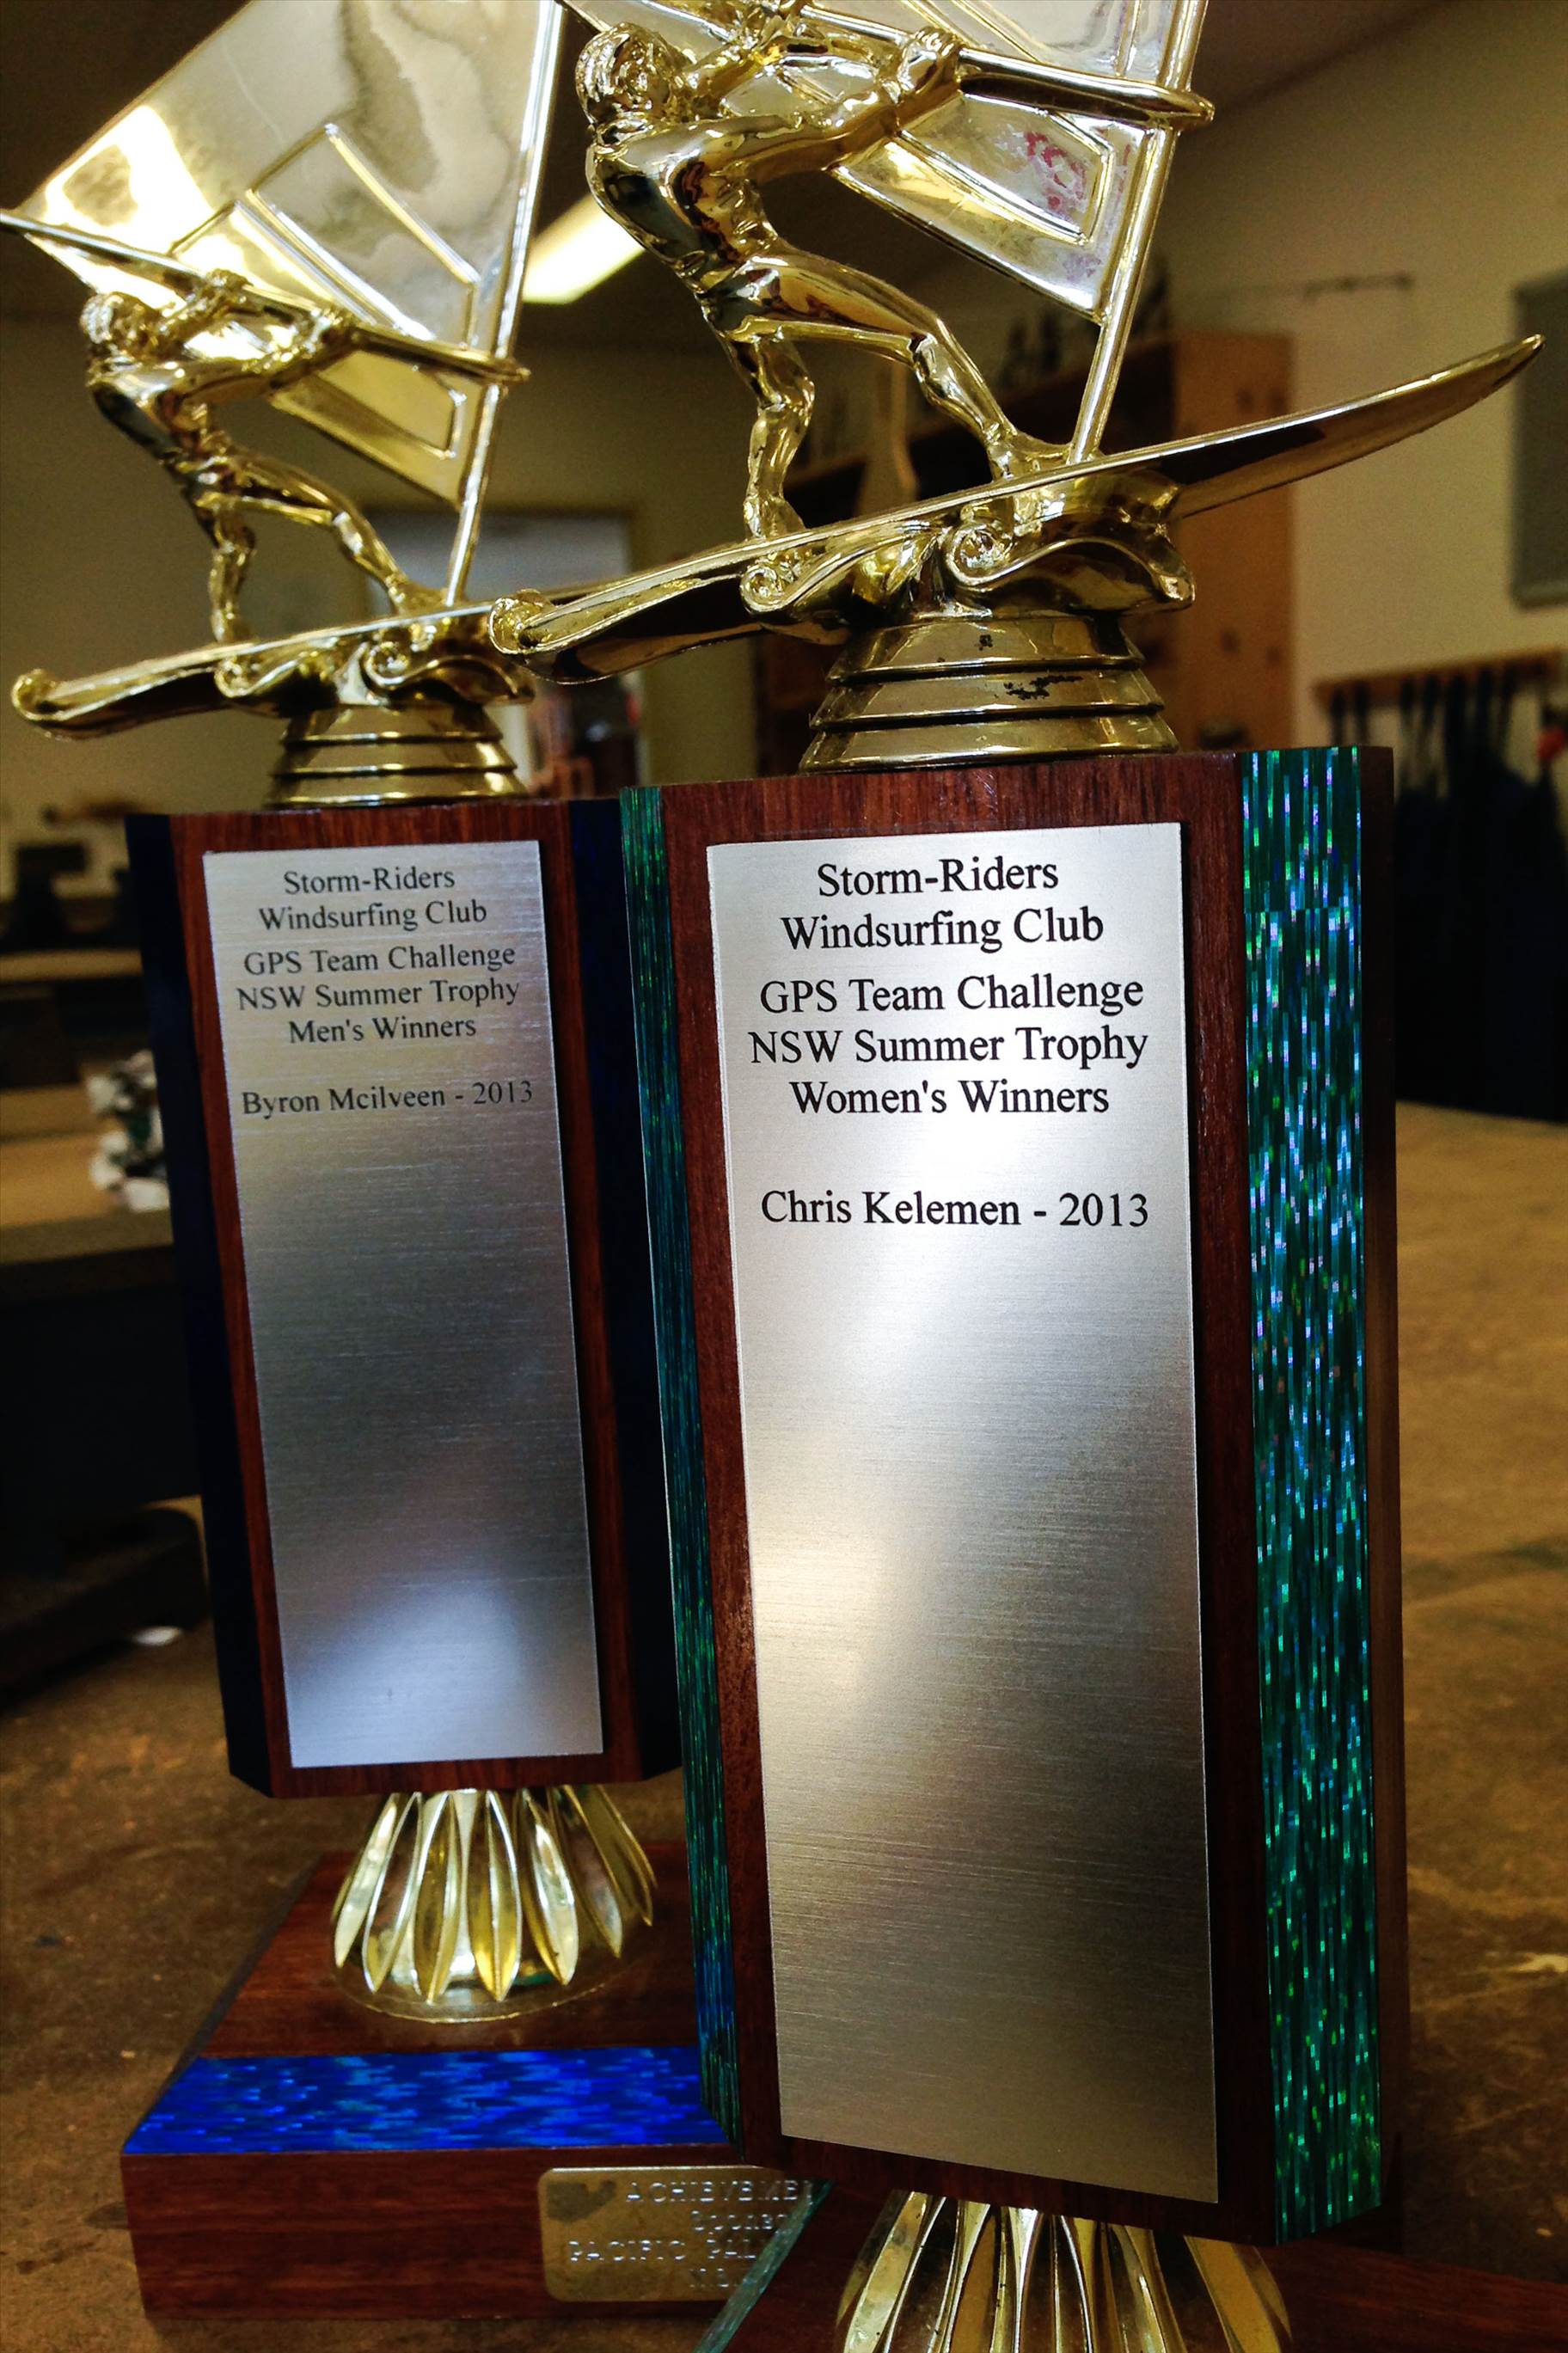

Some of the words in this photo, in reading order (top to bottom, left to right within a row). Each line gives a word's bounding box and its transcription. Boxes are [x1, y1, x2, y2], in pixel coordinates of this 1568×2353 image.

[284, 866, 456, 894] Storm-Riders
[817, 855, 1059, 898] Storm-Riders
[259, 902, 419, 932] Windsurfing
[425, 898, 487, 924] Club
[779, 910, 1002, 954] Windsurfing
[1014, 905, 1104, 943] Club
[243, 951, 302, 976] GPS
[309, 950, 378, 973] Team
[388, 943, 516, 972] Challenge
[236, 986, 302, 1010] NSW
[315, 984, 423, 1008] Summer
[429, 977, 519, 1008] Trophy
[760, 979, 837, 1014] GPS
[848, 978, 945, 1012] Team
[957, 972, 1144, 1017] Challenge
[288, 1019, 364, 1044] Men's
[372, 1015, 477, 1039] Winners
[747, 1030, 843, 1063] NSW
[854, 1028, 1005, 1063] Summer
[1014, 1024, 1149, 1070] Trophy
[242, 1092, 320, 1120] Byron
[328, 1086, 445, 1111] Mcilveen
[473, 1080, 532, 1105] 2013
[788, 1080, 947, 1114] Women's
[958, 1078, 1110, 1113] Winners
[761, 1189, 852, 1223] Chris
[861, 1190, 1022, 1226] Kelemen
[1059, 1192, 1148, 1228] 2013
[706, 2238, 766, 2260] PAL
